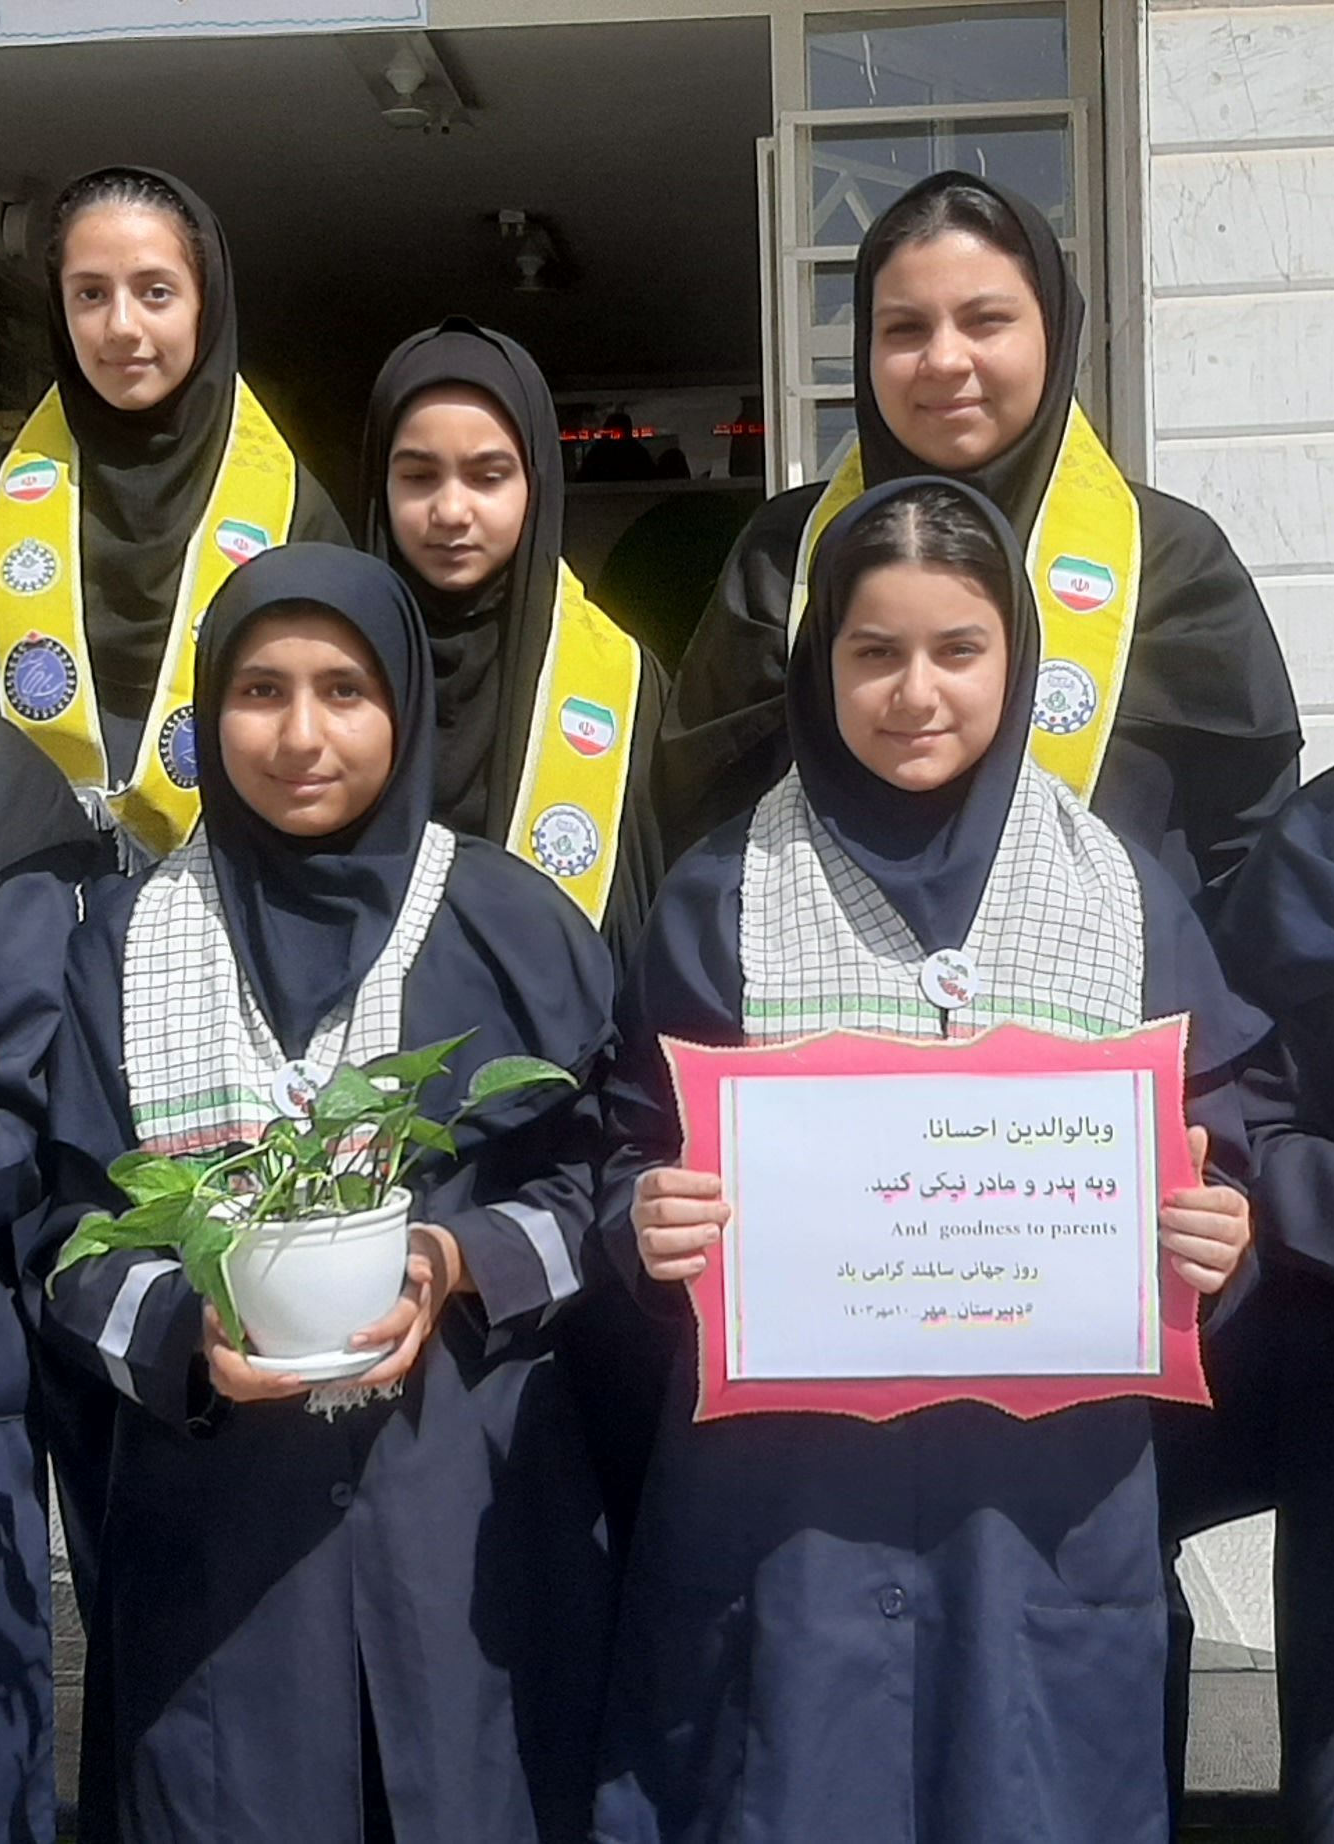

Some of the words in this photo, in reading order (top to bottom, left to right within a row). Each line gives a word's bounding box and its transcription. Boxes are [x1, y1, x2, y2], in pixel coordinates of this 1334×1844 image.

[922, 1117, 997, 1139] احسانا.
[1005, 1115, 1114, 1145] وبالوالدین
[864, 1171, 912, 1199] کنید.
[919, 1171, 967, 1199] نیکی
[973, 1171, 1017, 1197] مادر
[1023, 1178, 1036, 1198] و
[1042, 1175, 1076, 1204] پدر
[1084, 1175, 1117, 1199] وبه
[891, 1220, 928, 1237] And
[939, 1219, 1021, 1240] goodness
[1026, 1222, 1045, 1236] to
[1050, 1221, 1118, 1240] parents
[836, 1261, 856, 1282] باد
[861, 1260, 905, 1282] گرامی
[960, 1260, 1006, 1281] جهانی
[1012, 1262, 1039, 1281] روز
